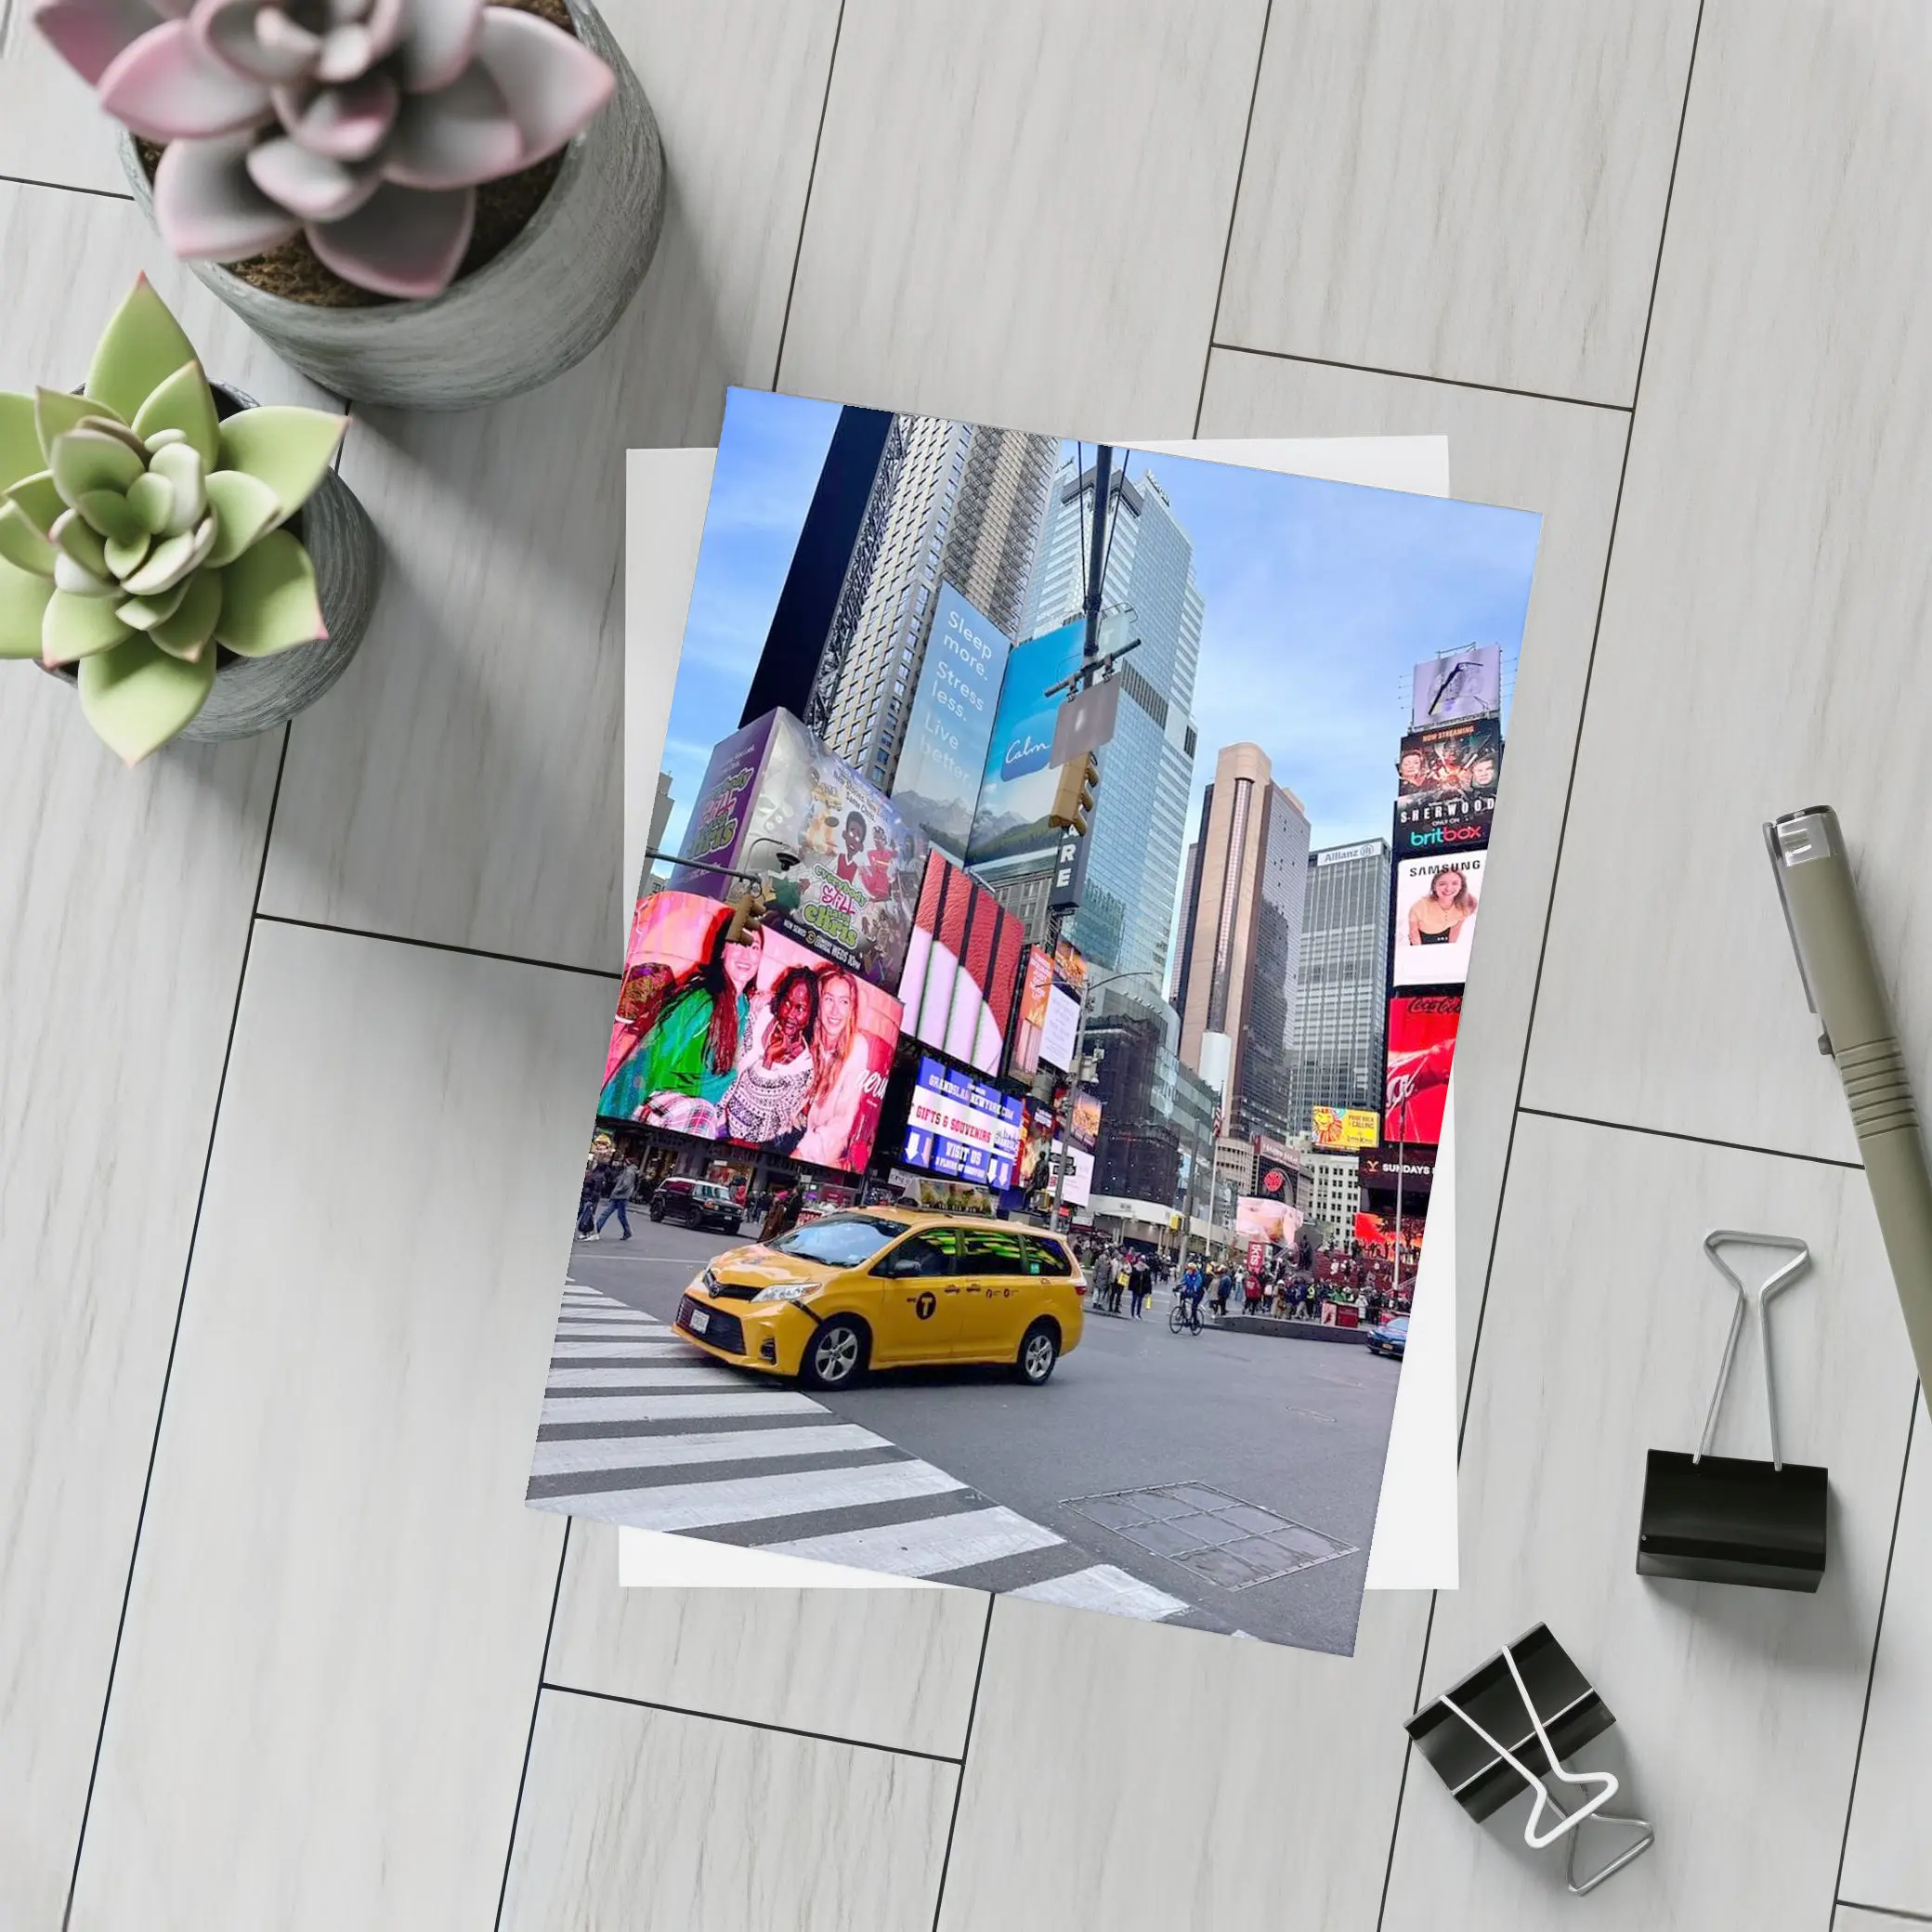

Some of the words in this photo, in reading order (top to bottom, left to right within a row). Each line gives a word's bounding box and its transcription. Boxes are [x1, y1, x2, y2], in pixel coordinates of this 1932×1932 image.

[948, 610, 992, 659] Sleep
[944, 634, 988, 681] more.
[936, 661, 985, 711] Stress
[932, 679, 967, 722] less.
[924, 711, 959, 750] Live
[1006, 736, 1051, 764] Calm
[1401, 798, 1495, 823] SHERWOOD
[1411, 825, 1482, 846] britbox
[1325, 850, 1358, 863] Allianz
[1409, 859, 1481, 878] SAMSUNG
[916, 1104, 941, 1125] GIFTS
[950, 1118, 992, 1144] SOUVENIRS
[946, 1142, 971, 1161] VISIT
[971, 1149, 982, 1166] US
[1382, 1163, 1430, 1175] SUNDAYS
